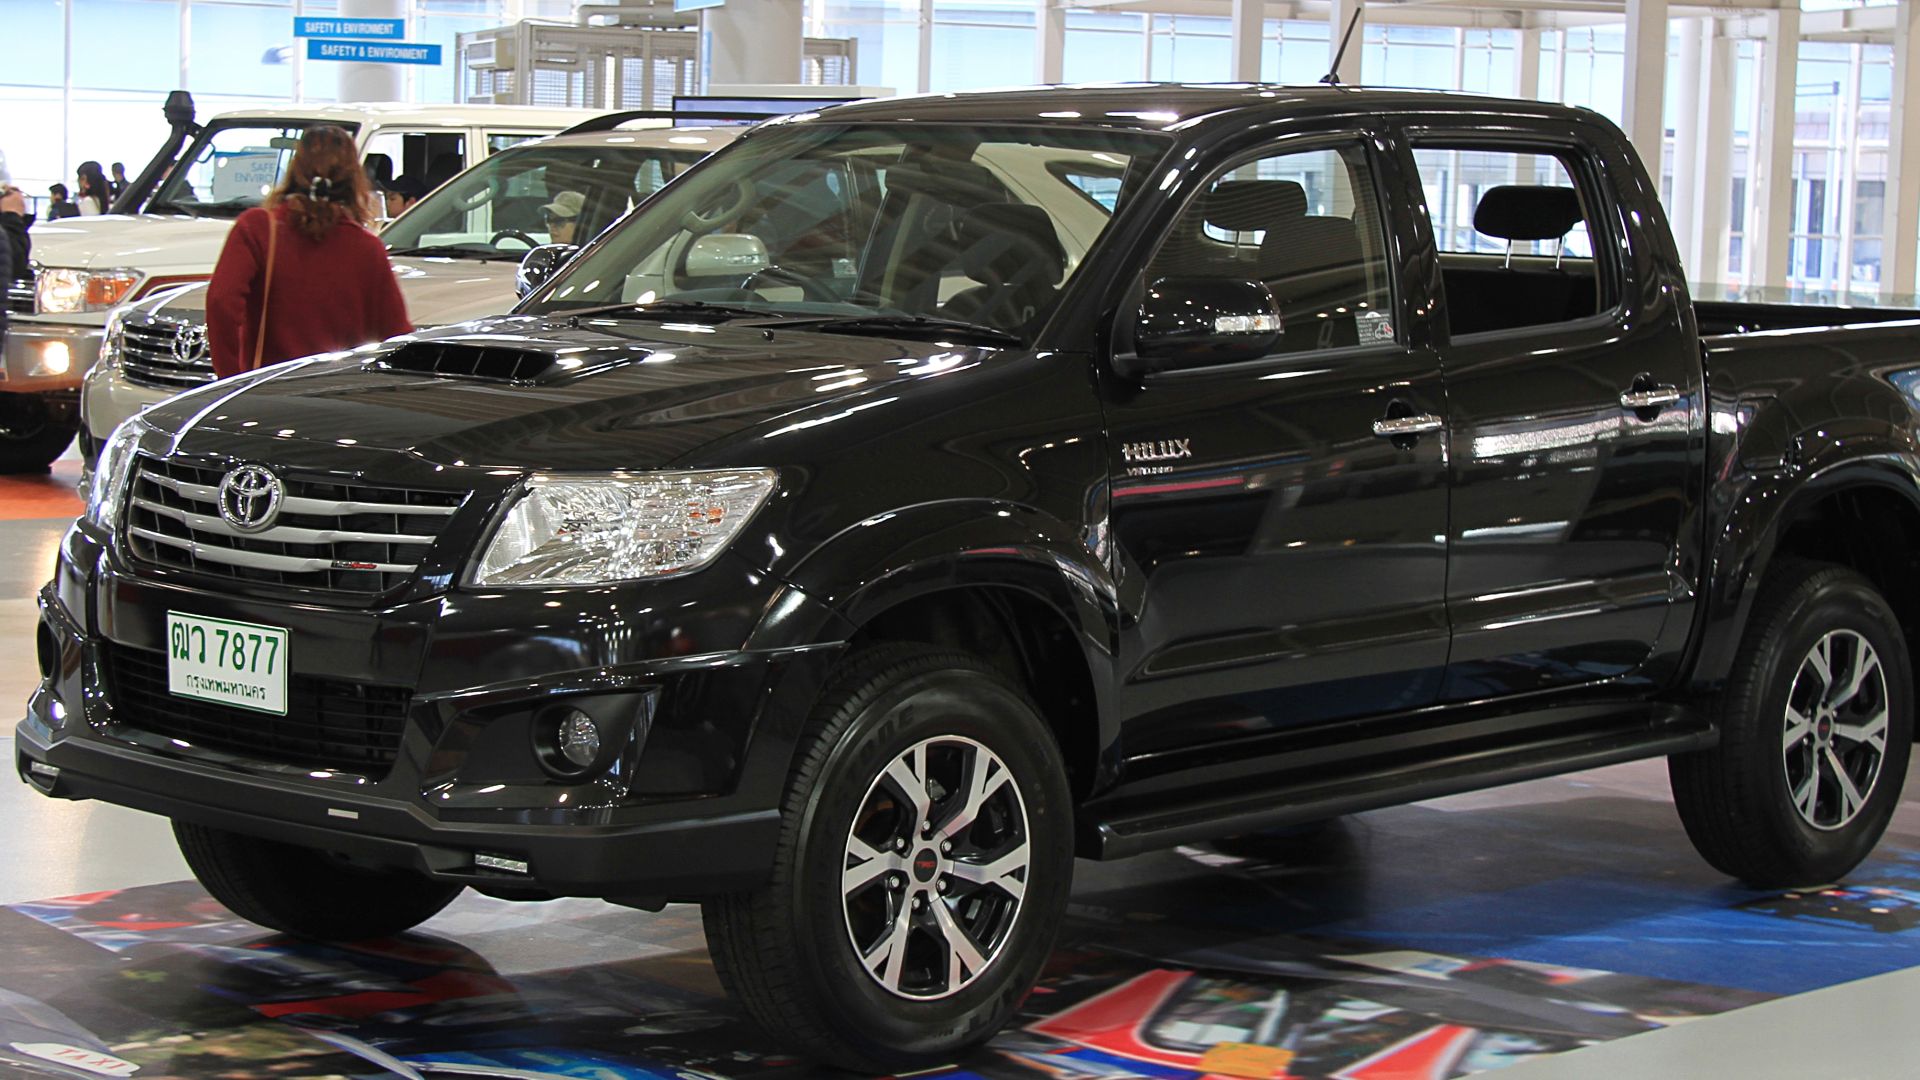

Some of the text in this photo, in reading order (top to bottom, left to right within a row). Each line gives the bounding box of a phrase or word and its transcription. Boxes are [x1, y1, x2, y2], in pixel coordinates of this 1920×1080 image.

[304, 22, 395, 35] SAFETY & ENVIRONMENT
[320, 44, 430, 60] SAFETY & ENVIRONMENT
[1122, 438, 1192, 461] HILUX
[215, 628, 279, 675] 7877
[186, 674, 267, 701] กรุงเทพมหานคร
[53, 1048, 127, 1070] TAXI
